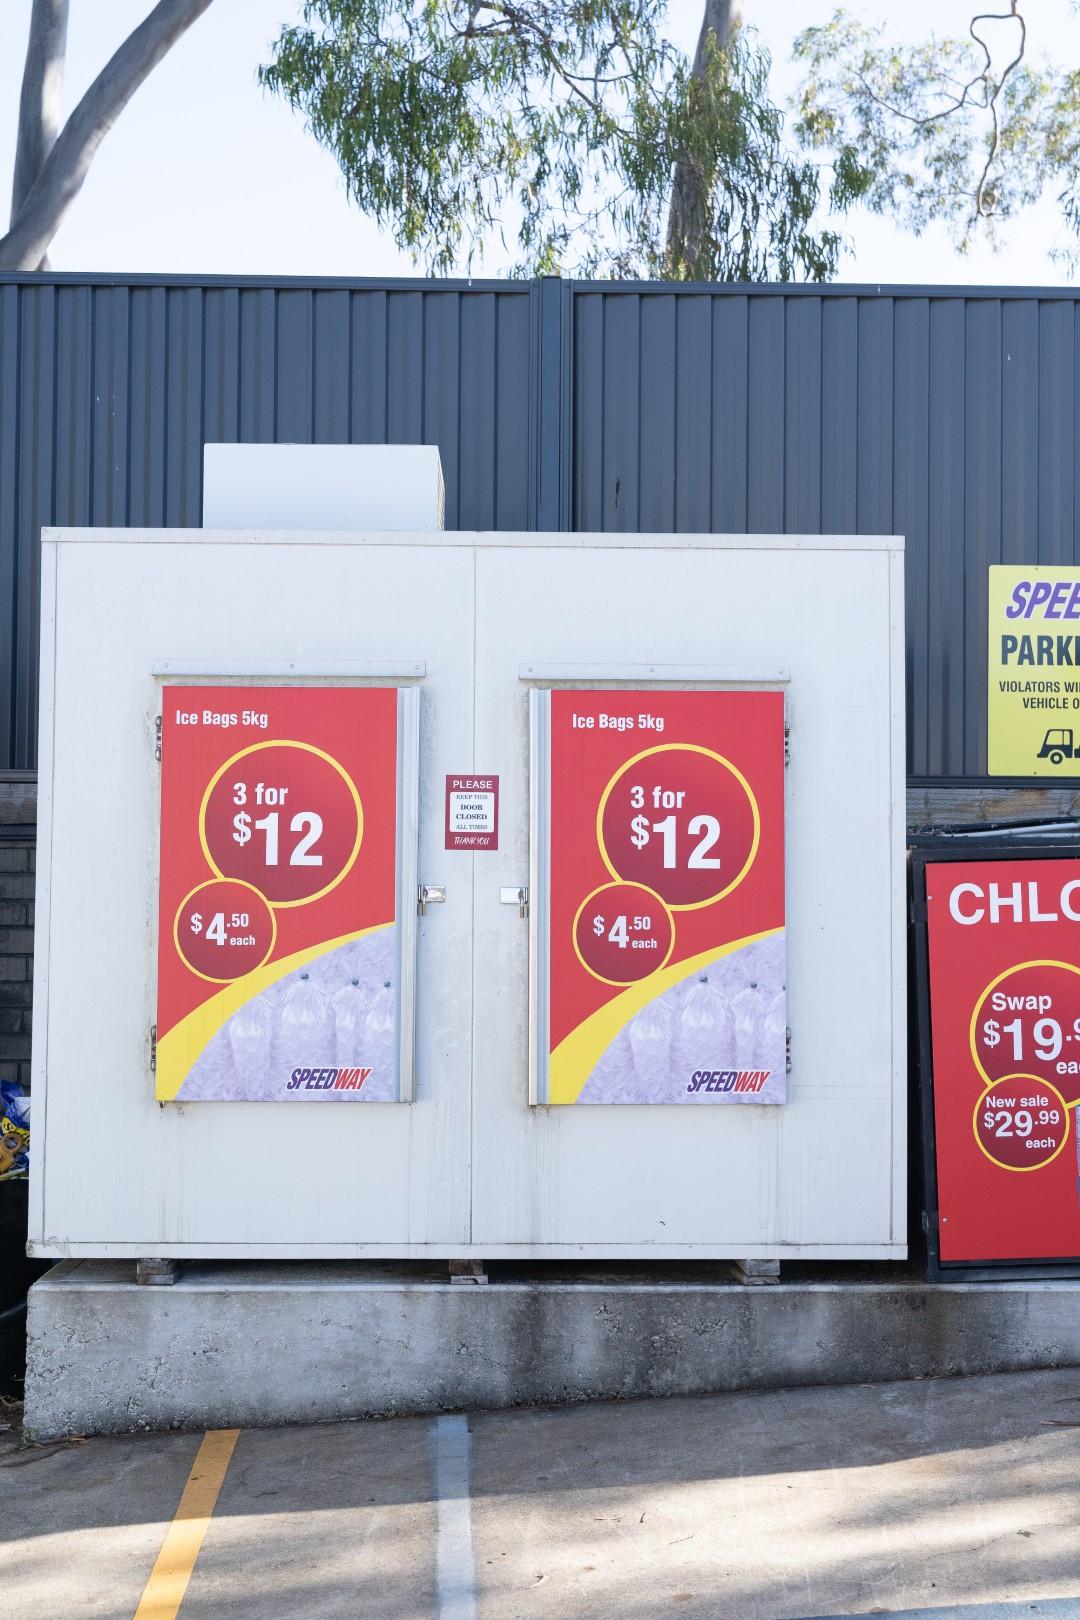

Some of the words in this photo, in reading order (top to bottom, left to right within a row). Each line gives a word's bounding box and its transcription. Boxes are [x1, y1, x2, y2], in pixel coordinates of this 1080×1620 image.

[999, 681, 1060, 693] VIOLATORS
[1064, 682, 1080, 693] WI
[1022, 697, 1068, 709] VEHICLE
[175, 710, 198, 725] Ice
[202, 710, 238, 729] Bags
[242, 710, 268, 729] 5kg
[572, 713, 595, 729] Ice
[599, 713, 634, 732] Bags
[638, 713, 665, 732] 5kg
[453, 780, 493, 789] PLEASE
[233, 783, 247, 806] 3
[255, 783, 288, 805] for
[631, 786, 644, 809] 3
[653, 786, 686, 809] for
[232, 811, 324, 866] $12
[454, 837, 476, 845] THANK
[477, 837, 490, 846] YOU
[630, 814, 721, 870] $12
[229, 935, 256, 946] each
[631, 938, 658, 949] each
[991, 992, 1052, 1015] Swap
[1056, 1061, 1080, 1074] ea
[286, 1067, 372, 1090] SPEEDWAY
[686, 1070, 771, 1092] SPEEDWAY
[986, 1096, 1016, 1108] New
[1020, 1095, 1049, 1107] sale
[984, 1110, 1060, 1137] $29.99
[1025, 1137, 1056, 1149] each
